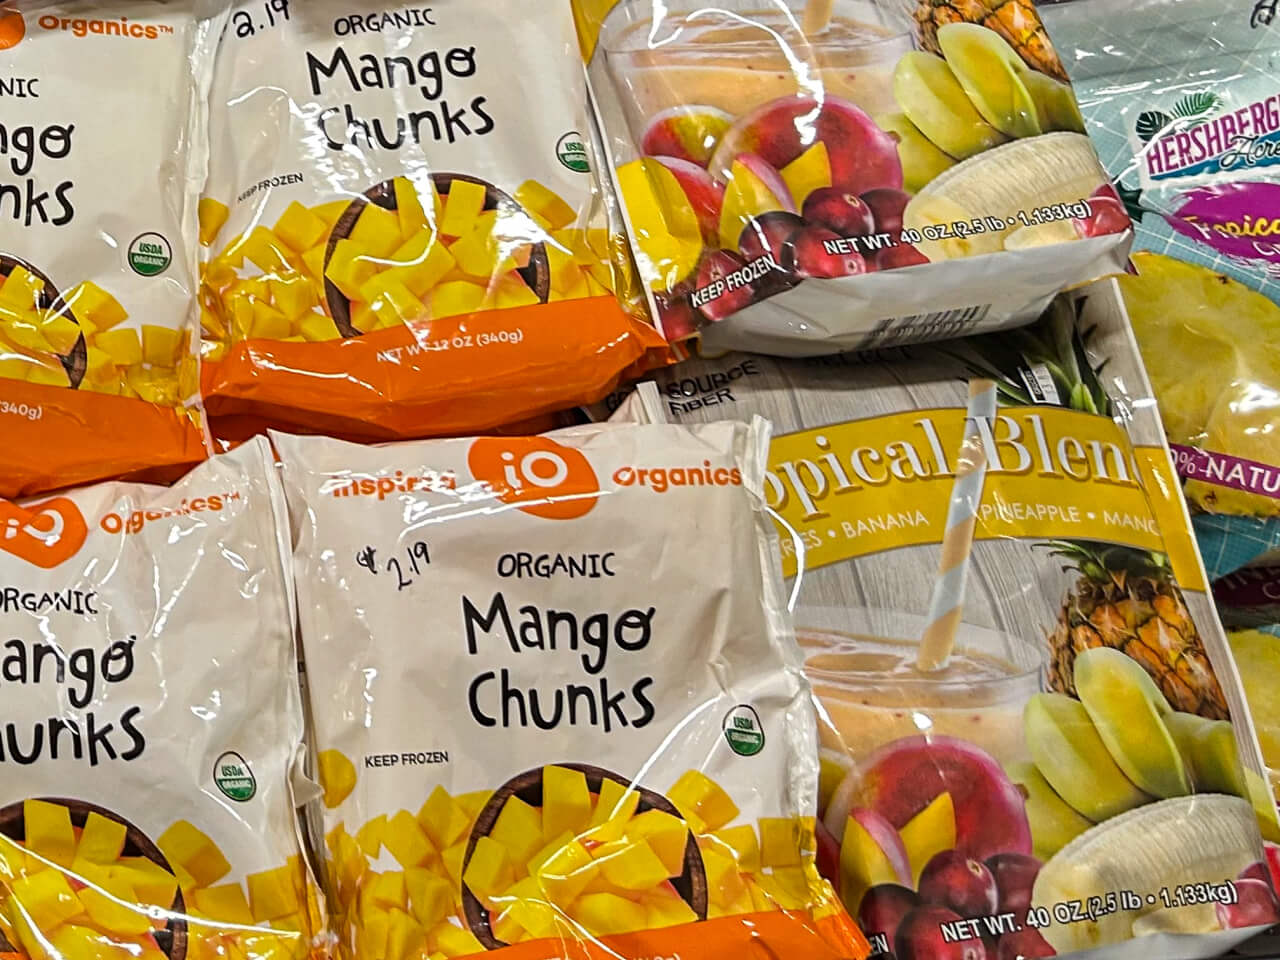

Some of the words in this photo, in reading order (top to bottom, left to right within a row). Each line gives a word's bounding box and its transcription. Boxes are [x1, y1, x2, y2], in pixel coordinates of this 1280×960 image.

[333, 7, 435, 35] ORGANIC
[306, 46, 475, 101] Mango
[318, 97, 493, 150] Chunks
[1145, 94, 1280, 176] HERSHBERG
[257, 172, 302, 193] FROZEN
[823, 239, 858, 257] NET
[863, 233, 898, 252] WT.
[899, 227, 919, 245] 40
[989, 217, 1005, 232] lb
[1017, 200, 1092, 226] 1.133kg)
[139, 243, 163, 253] USDA
[690, 285, 725, 308] KEEP
[726, 256, 774, 293] FROZEN
[452, 334, 473, 347] OZ
[475, 327, 524, 348] (340g)
[665, 359, 760, 399] SOURCE
[668, 388, 736, 416] FIBER
[761, 418, 954, 520] opical
[965, 414, 1142, 491] Blen
[1205, 456, 1280, 492] NATU
[842, 510, 928, 537] BANANA
[982, 504, 1080, 523] PINEAPPLE
[497, 553, 615, 578] ORGANIC
[462, 593, 655, 673] Mango
[468, 671, 655, 730] Chunks
[734, 717, 753, 728] USDA
[221, 766, 243, 777] USDA
[365, 754, 398, 768] KEEP
[402, 751, 448, 765] FROZEN
[940, 921, 980, 942] NET
[983, 913, 1021, 935] WT.
[1024, 909, 1048, 928] 40
[1119, 890, 1140, 908] lb
[1158, 880, 1237, 909] 1.133kg)
